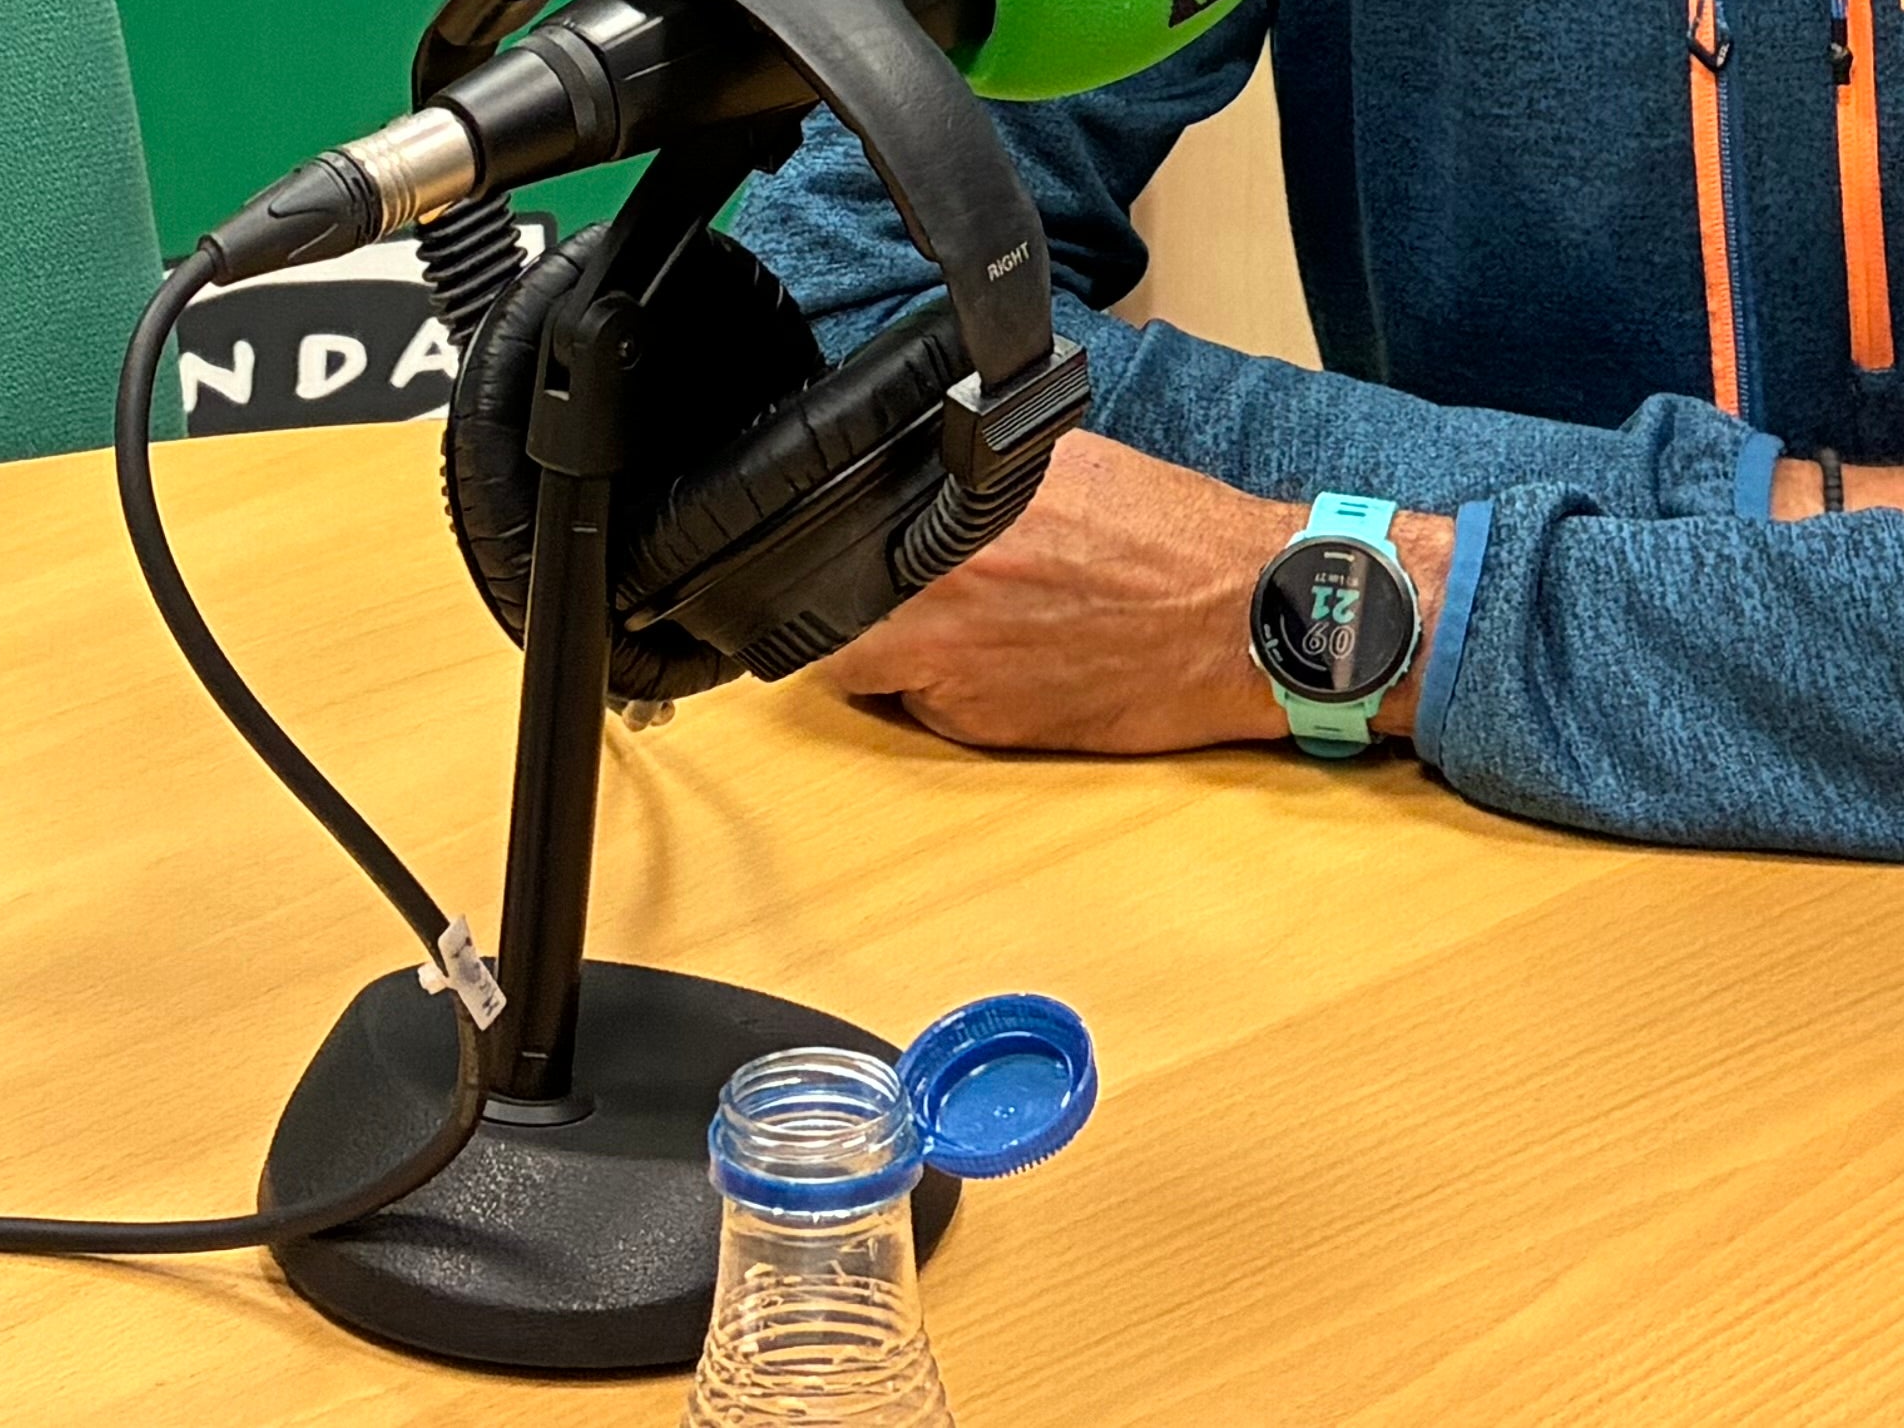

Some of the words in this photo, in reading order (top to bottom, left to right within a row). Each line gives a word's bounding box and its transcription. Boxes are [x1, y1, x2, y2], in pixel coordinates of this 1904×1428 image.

[986, 240, 1030, 282] RIGHT
[179, 316, 459, 414] NDA
[1311, 585, 1361, 624] 21
[1302, 621, 1356, 660] 09
